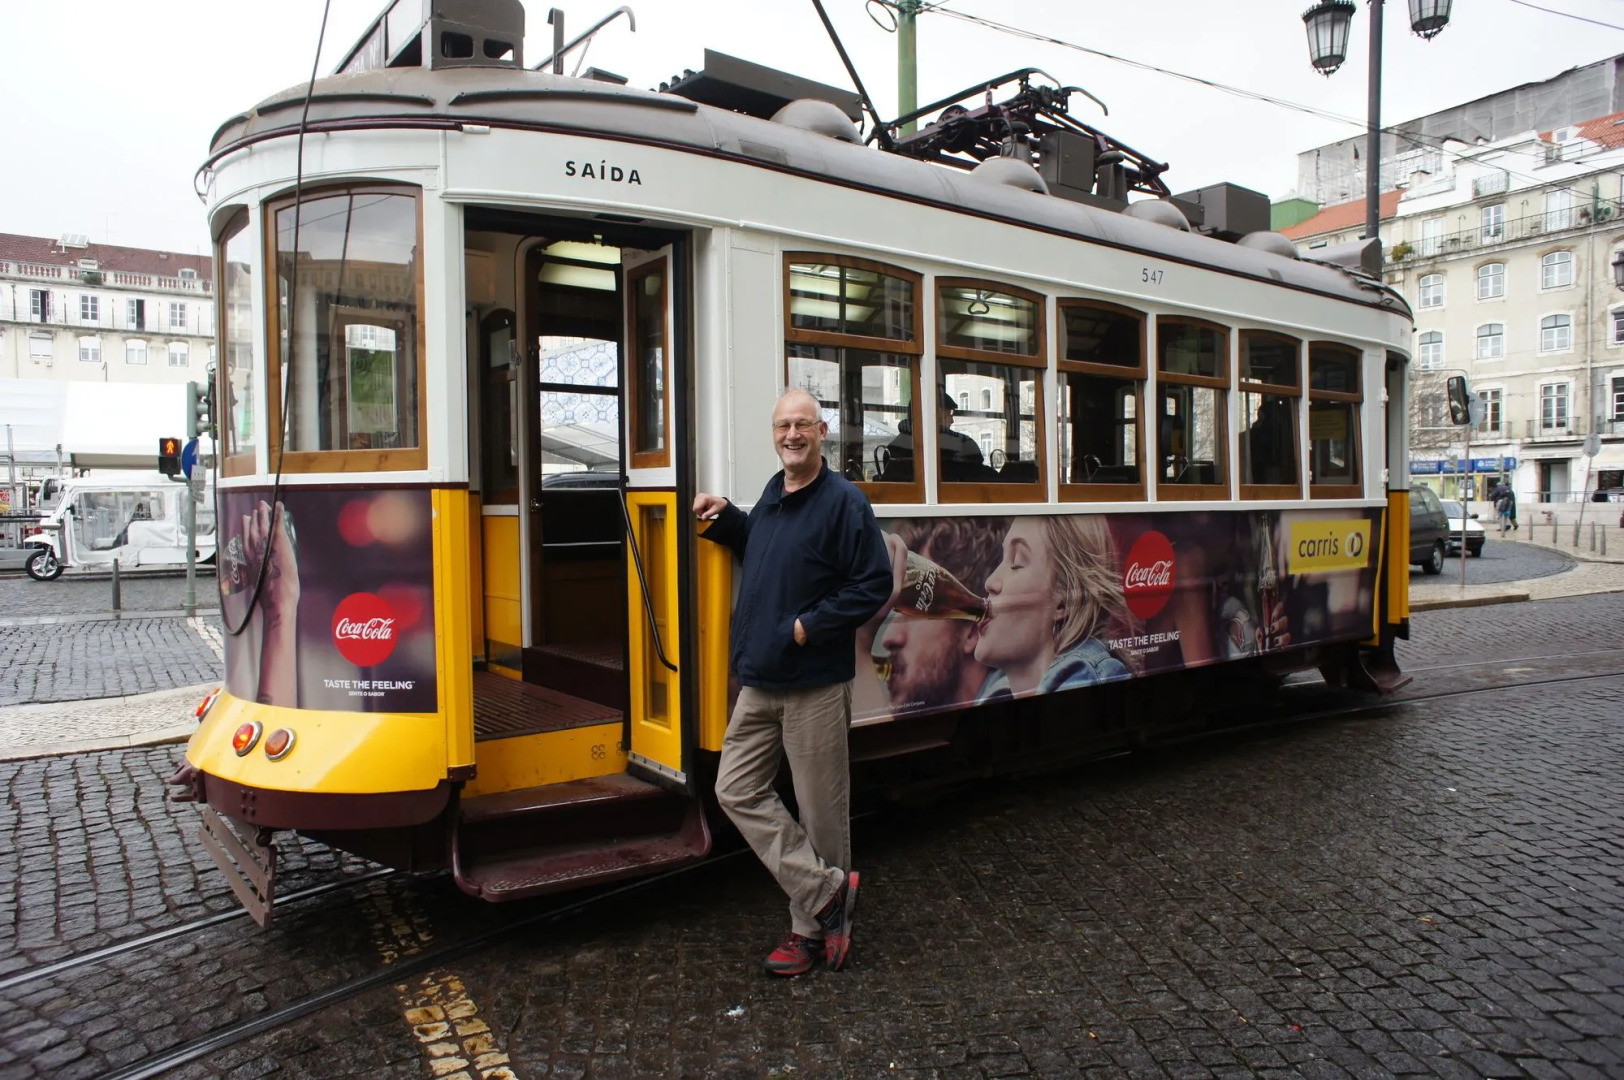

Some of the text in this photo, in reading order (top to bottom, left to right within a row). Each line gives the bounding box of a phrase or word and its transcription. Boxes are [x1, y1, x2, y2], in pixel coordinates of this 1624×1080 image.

[565, 159, 642, 186] SAÍDA
[1142, 267, 1164, 285] 547
[1298, 530, 1339, 558] carris
[1125, 560, 1174, 589] Coca-Cola
[335, 617, 396, 640] Coca-Cola
[1108, 630, 1180, 651] TASTE THE FEELING
[323, 679, 413, 691] TASTE THE FEELING
